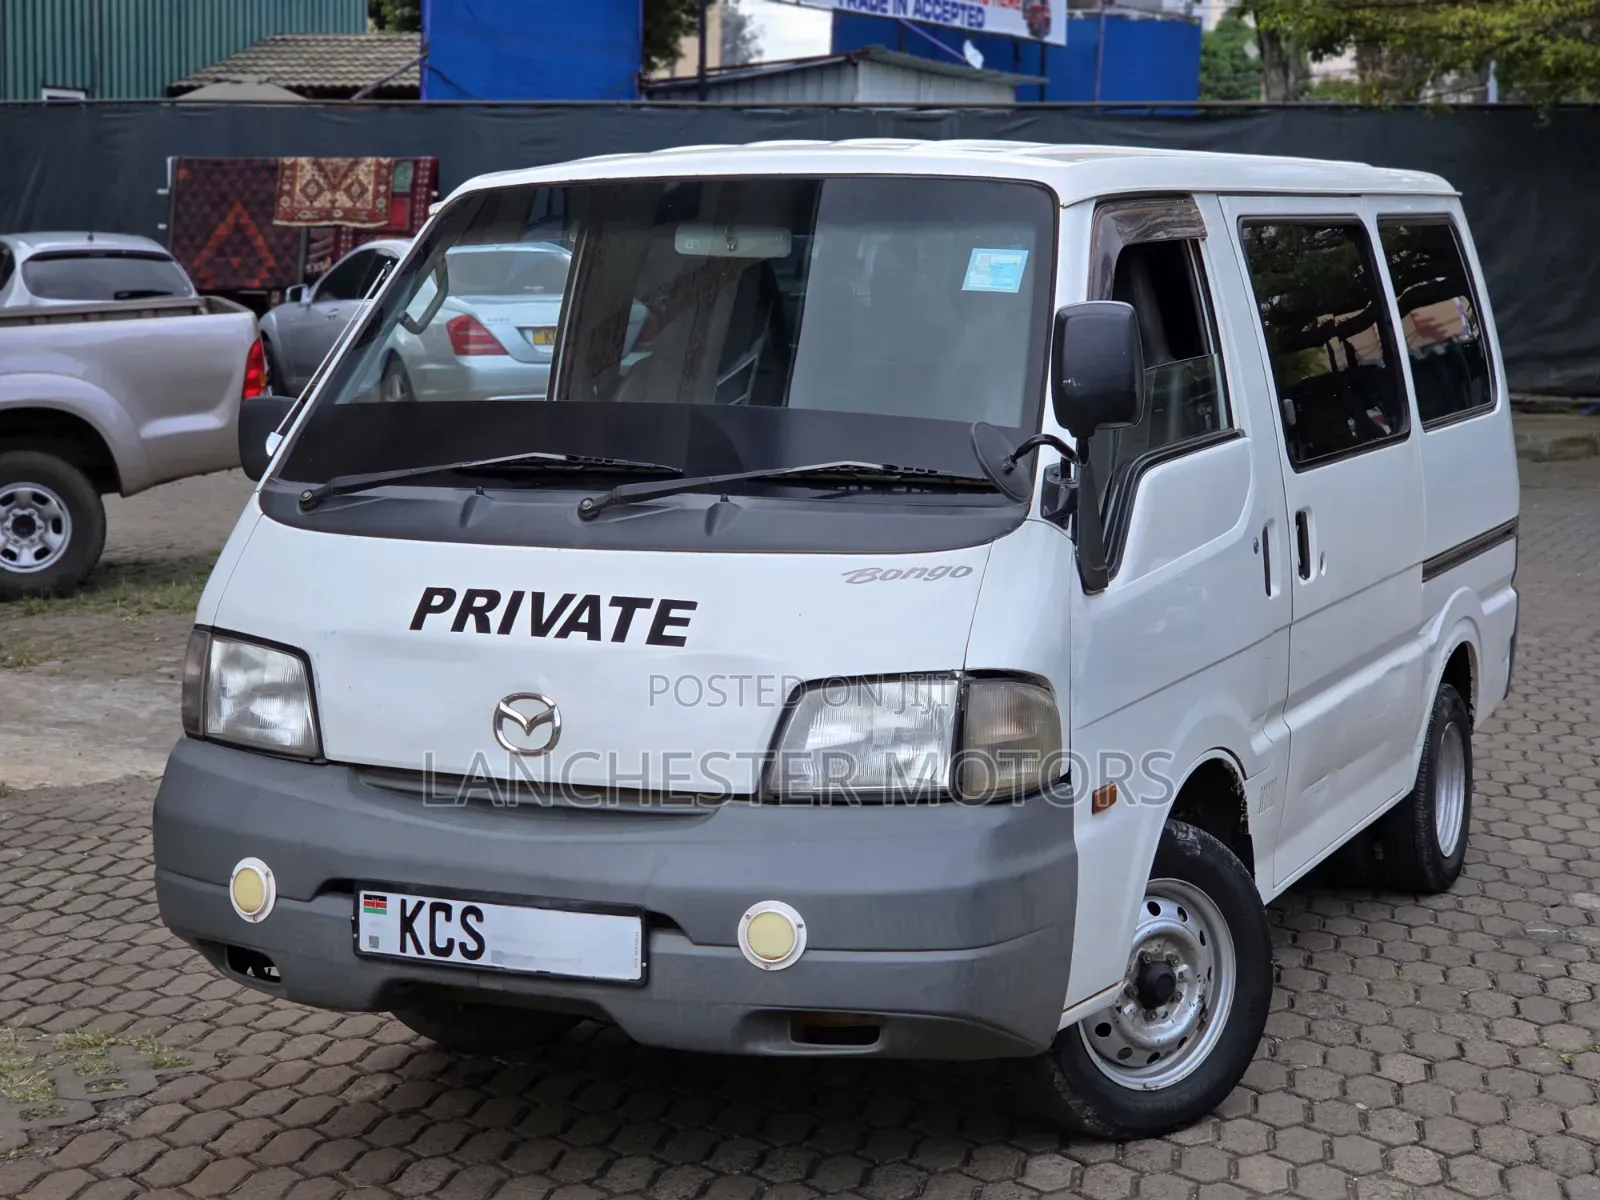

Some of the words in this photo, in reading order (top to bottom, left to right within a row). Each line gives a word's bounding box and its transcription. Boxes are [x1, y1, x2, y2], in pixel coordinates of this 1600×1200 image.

[913, 0, 986, 29] ACCEPTED
[841, 565, 973, 584] Bongo
[409, 586, 698, 647] PRIVATE
[400, 898, 486, 961] KCS
